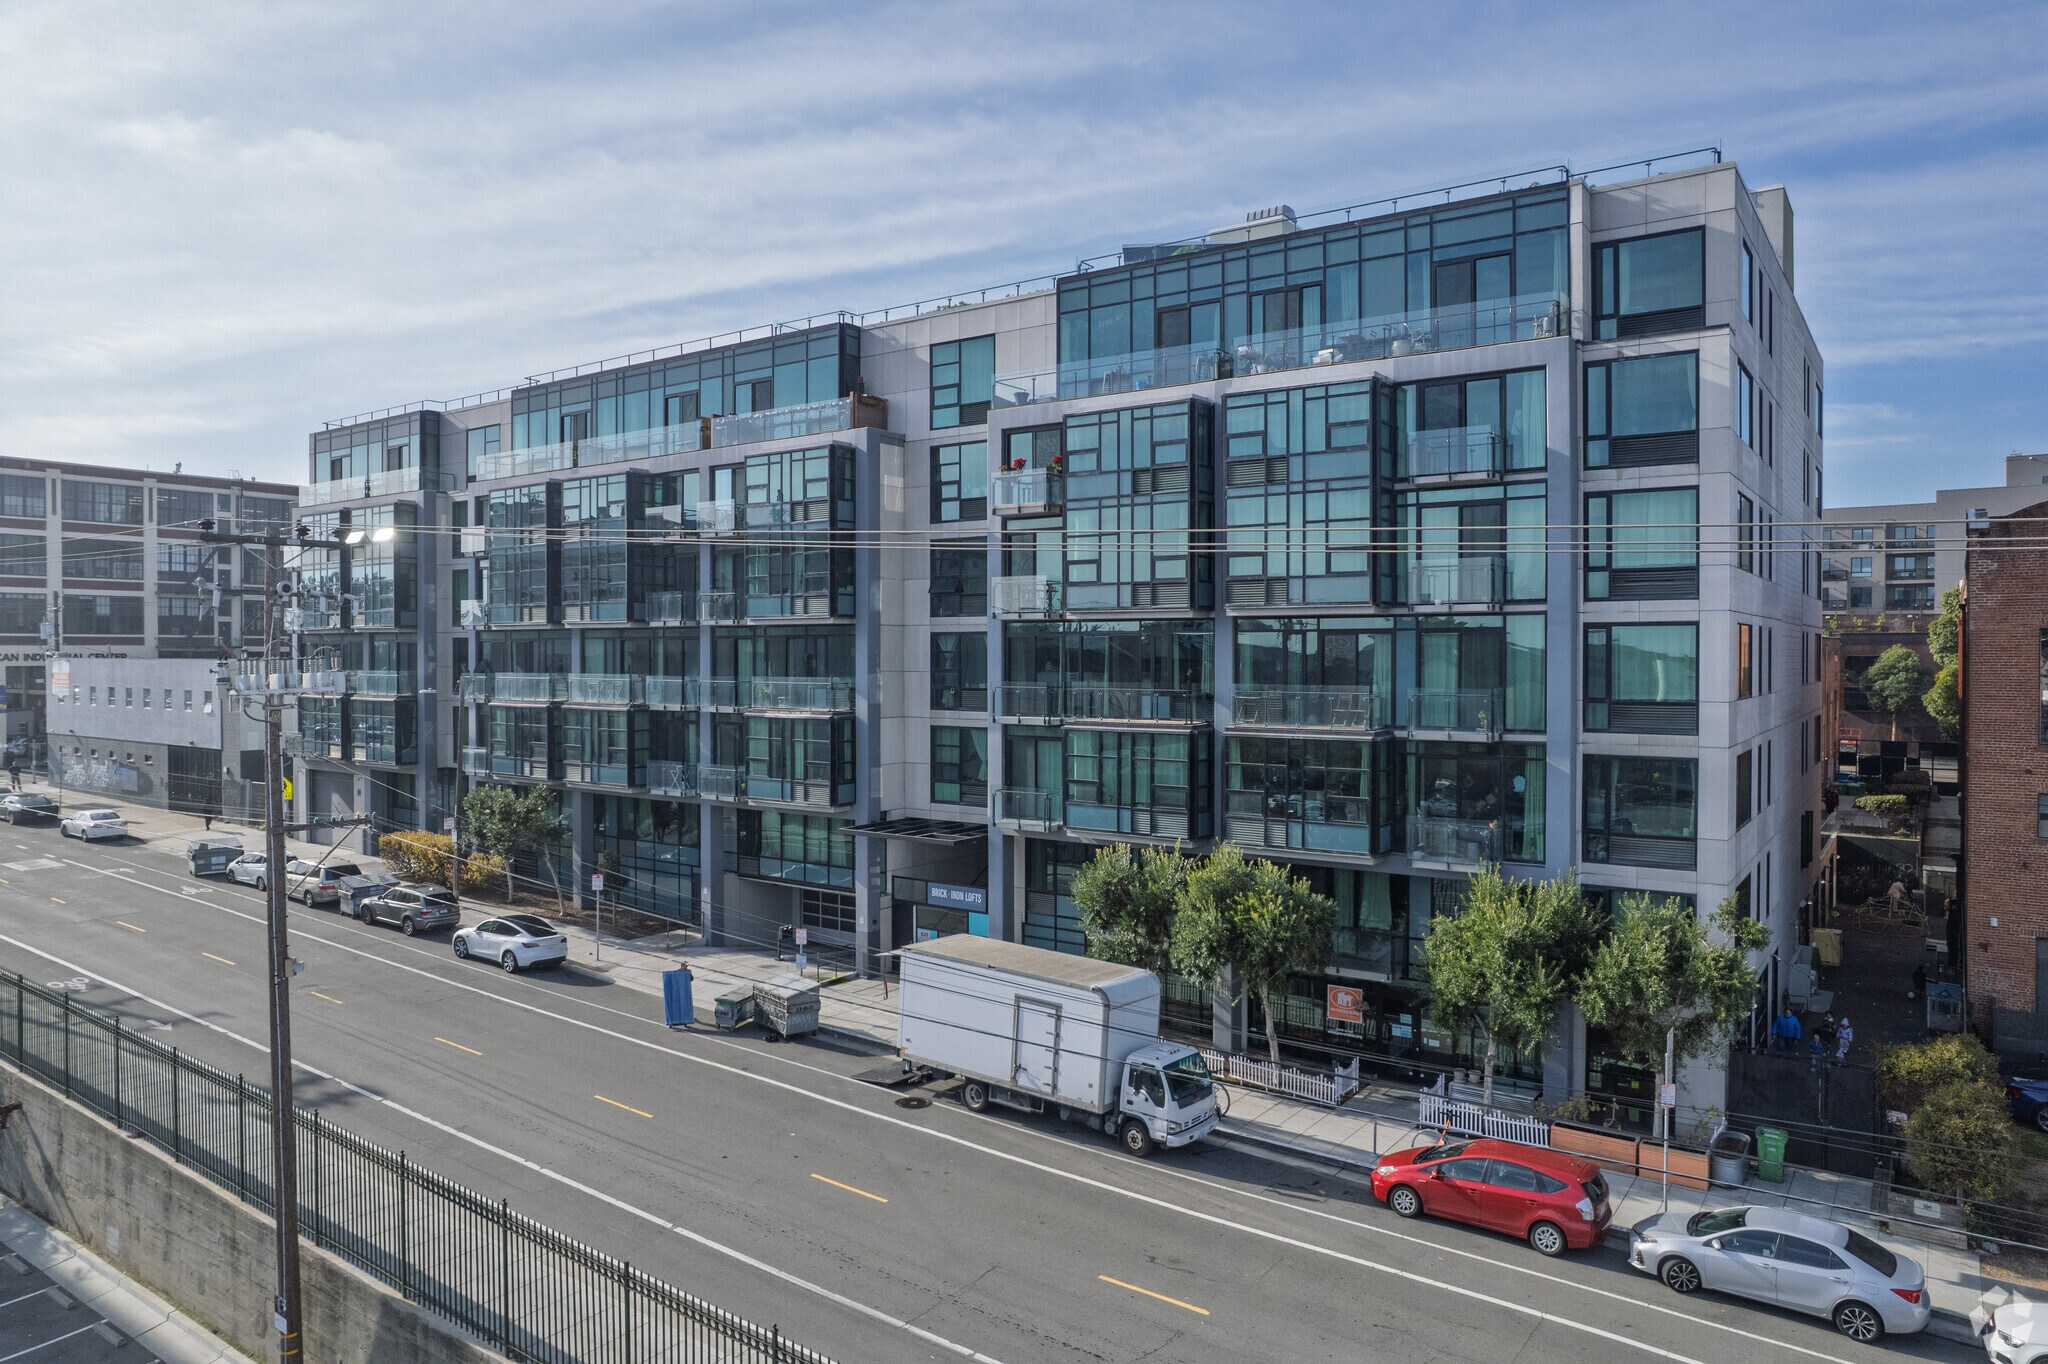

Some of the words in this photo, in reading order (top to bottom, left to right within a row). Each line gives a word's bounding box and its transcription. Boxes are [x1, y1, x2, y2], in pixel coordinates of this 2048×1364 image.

[931, 888, 948, 898] BRICK
[951, 890, 964, 900] IRON
[965, 892, 982, 903] LOFTS
